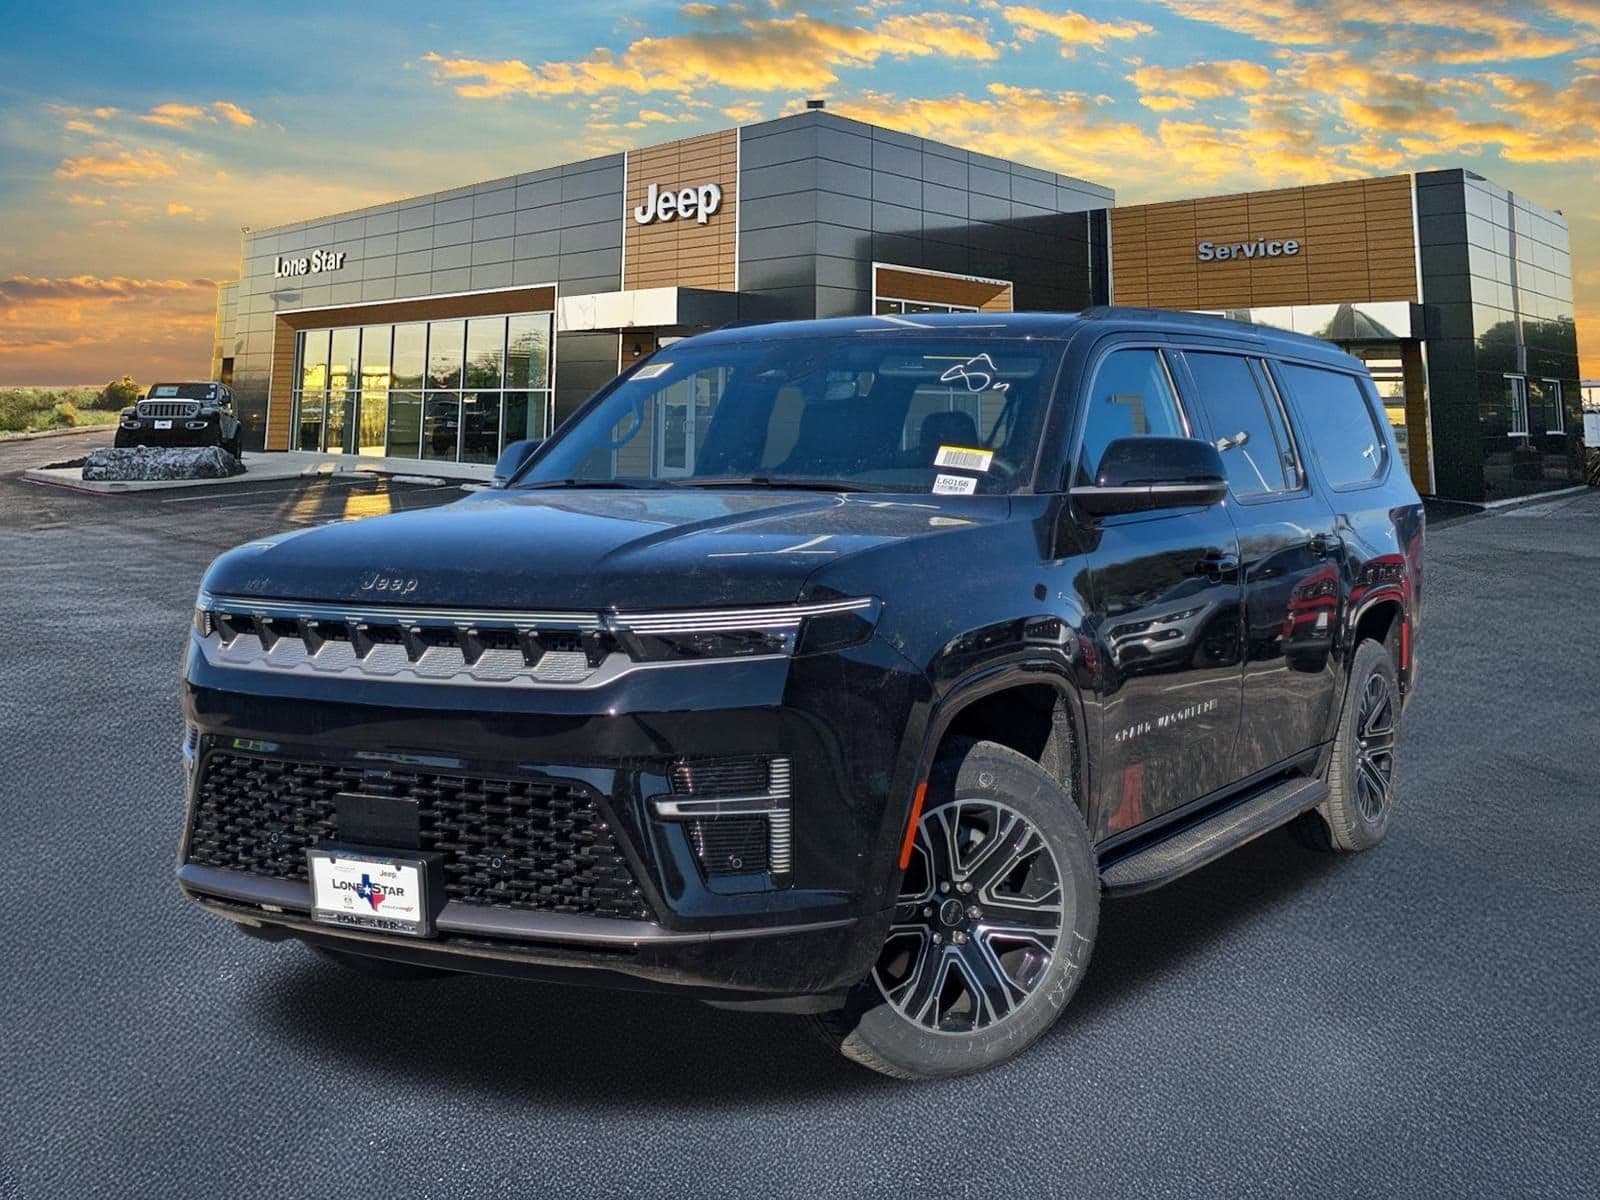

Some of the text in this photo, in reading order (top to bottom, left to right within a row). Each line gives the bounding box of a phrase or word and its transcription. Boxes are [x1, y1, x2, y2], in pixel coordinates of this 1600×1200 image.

[634, 183, 721, 225] Jeep
[1198, 236, 1299, 261] Service
[274, 249, 346, 278] Lone Star
[361, 573, 419, 595] Jeep
[379, 870, 397, 879] Jeep
[331, 878, 405, 896] LONE STAR
